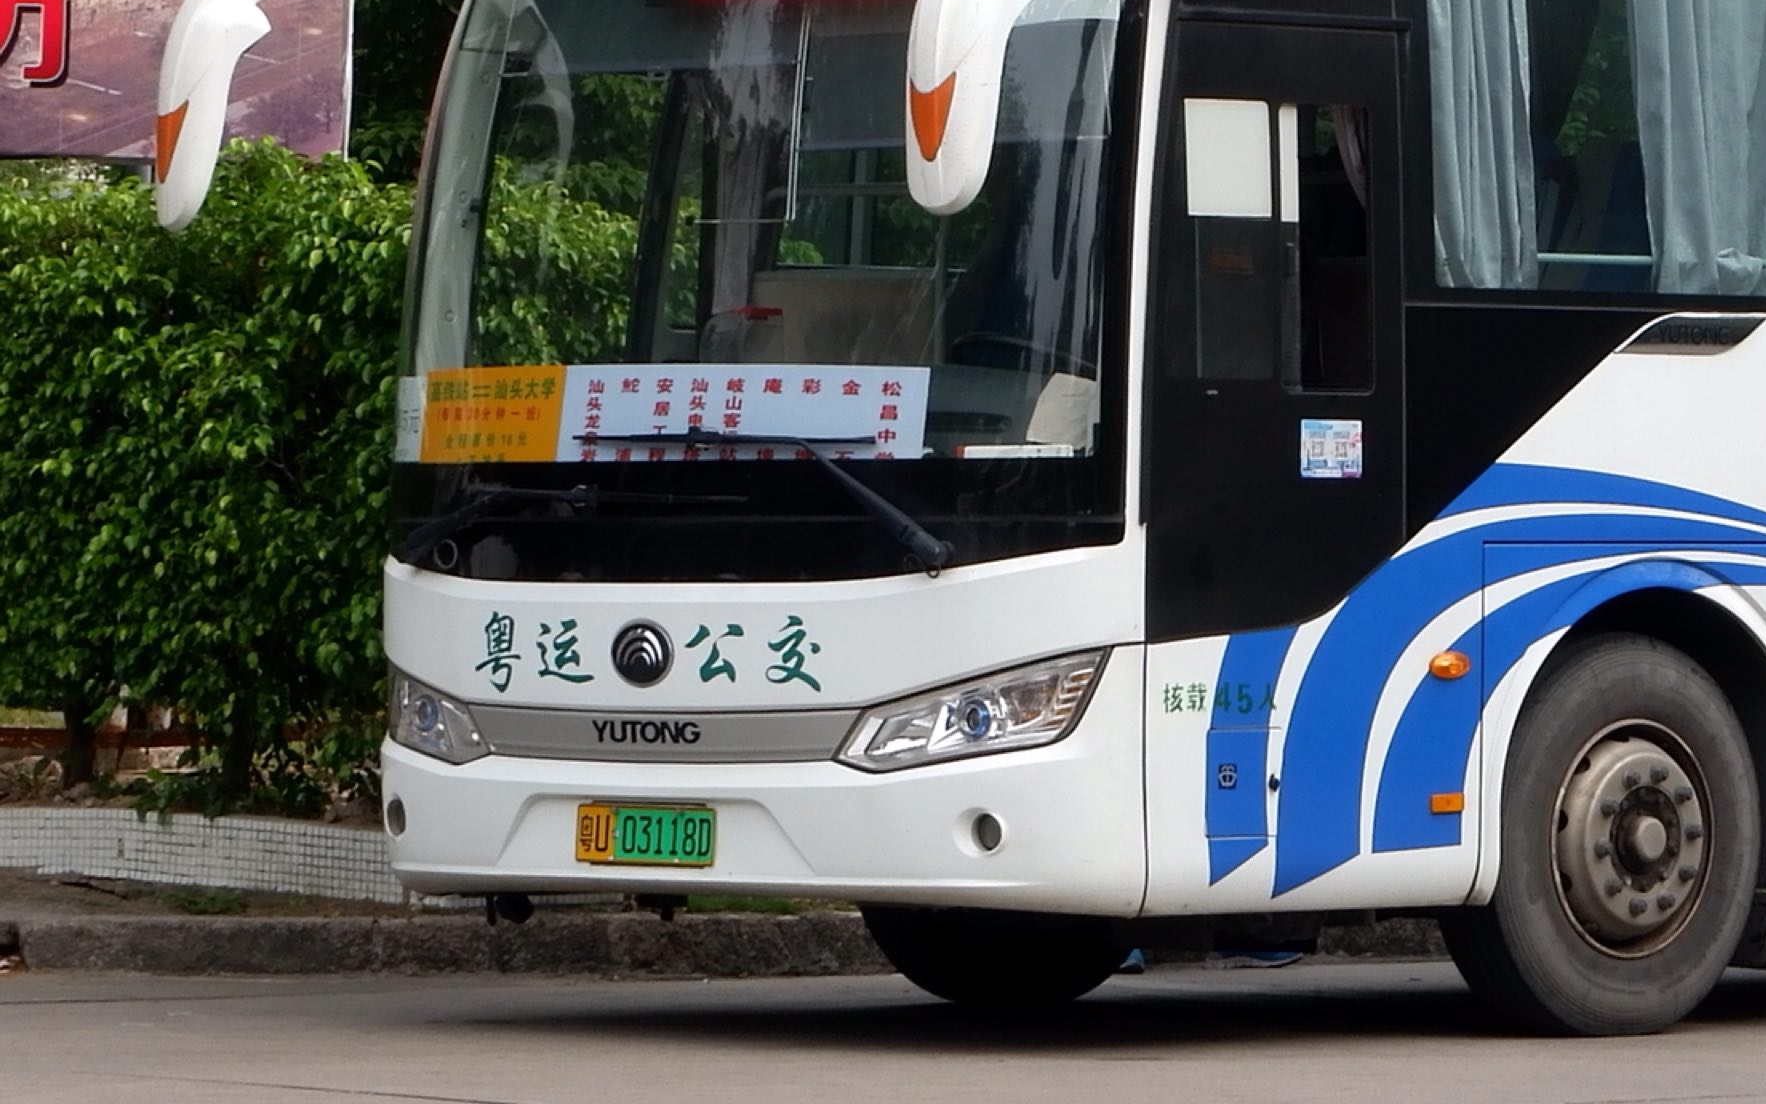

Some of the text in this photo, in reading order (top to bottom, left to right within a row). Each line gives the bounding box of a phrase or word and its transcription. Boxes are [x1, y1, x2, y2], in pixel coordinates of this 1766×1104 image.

[1657, 325, 1731, 344] YUTONG
[475, 610, 822, 693] 粤运 公交
[592, 719, 701, 745] YUTONG
[620, 814, 713, 858] 03118D
